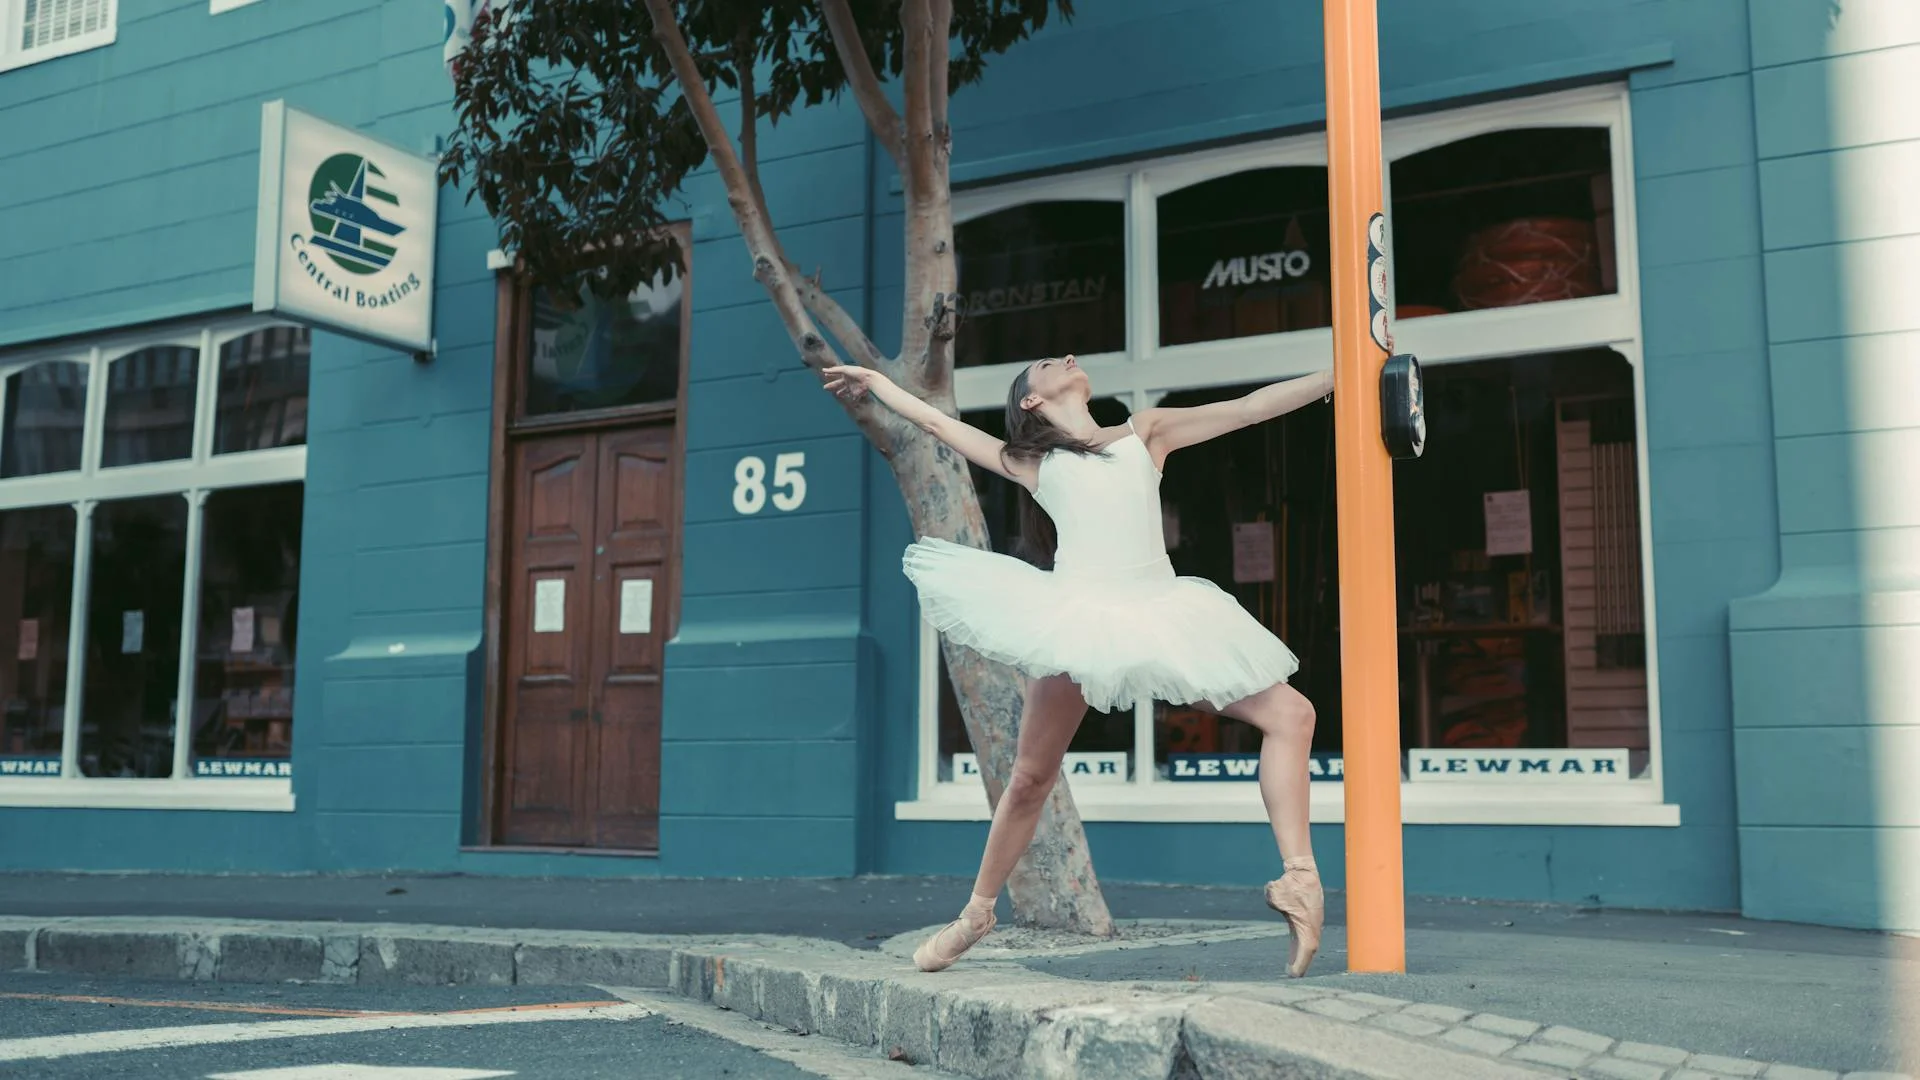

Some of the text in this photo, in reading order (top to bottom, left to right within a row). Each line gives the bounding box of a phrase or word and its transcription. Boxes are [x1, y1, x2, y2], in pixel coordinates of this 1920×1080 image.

[291, 233, 421, 308] Central Boating
[1202, 250, 1310, 289] MUSTO
[969, 276, 1107, 312] RONSTAN
[733, 452, 807, 515] 85
[198, 760, 292, 776] LEWMAR
[1174, 759, 1344, 777] LEWAR
[1420, 758, 1617, 773] LEWMAR
